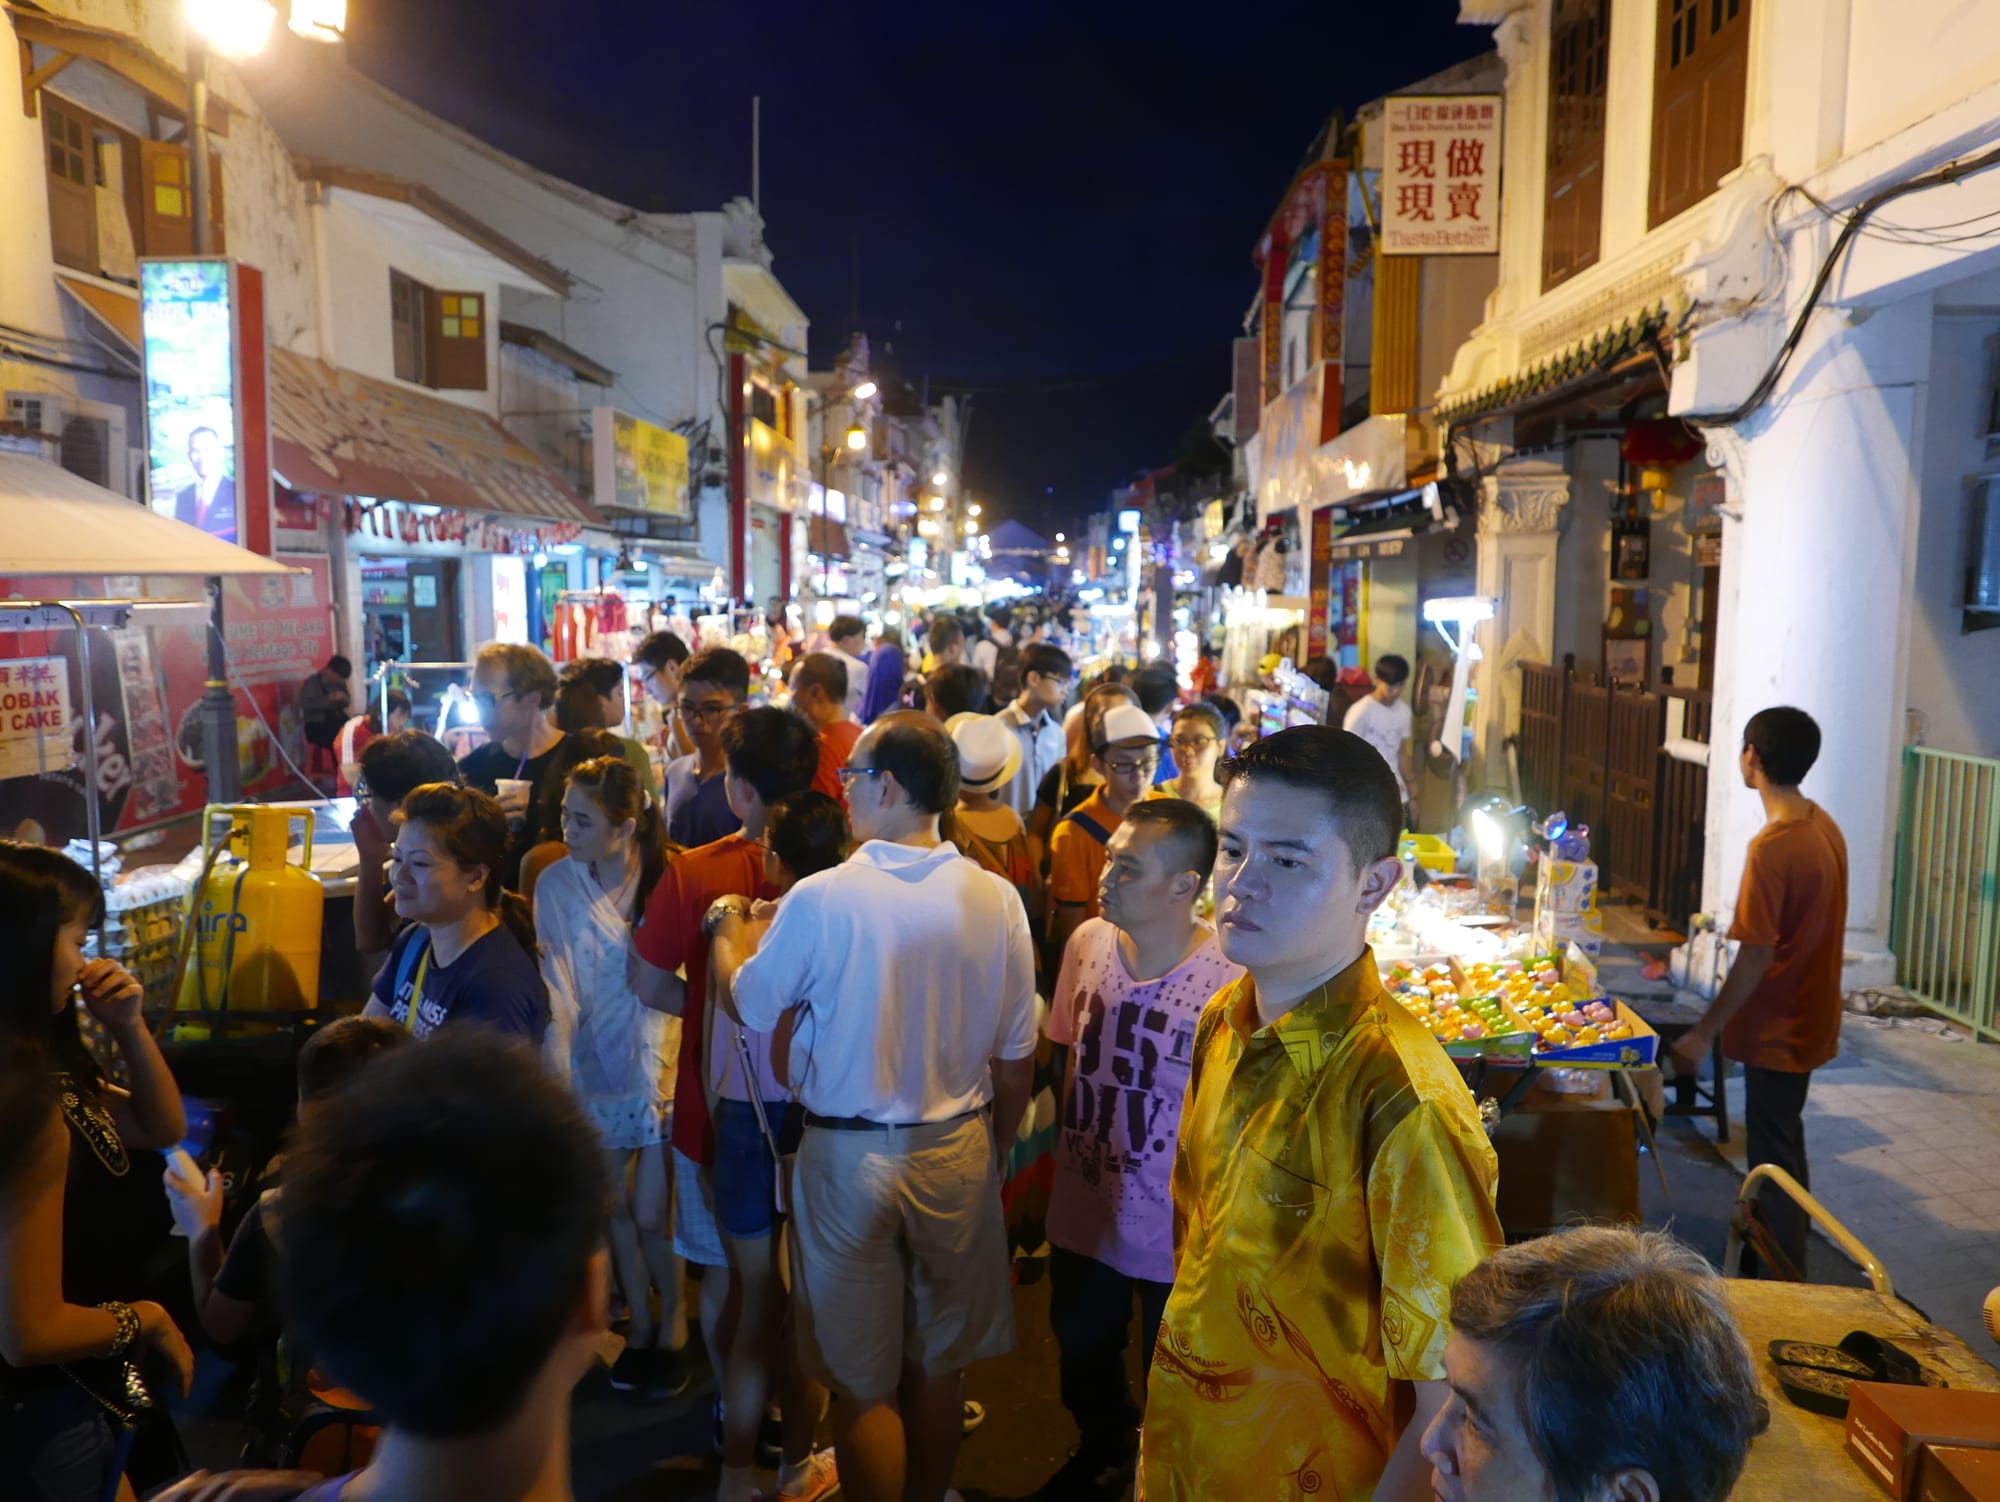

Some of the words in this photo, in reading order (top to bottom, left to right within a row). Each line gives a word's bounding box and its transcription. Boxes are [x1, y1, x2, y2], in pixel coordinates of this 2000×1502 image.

[1397, 138, 1484, 178] 現做
[1396, 182, 1483, 221] 現賣
[0, 689, 60, 711] OBAK
[11, 710, 62, 731] CAKE
